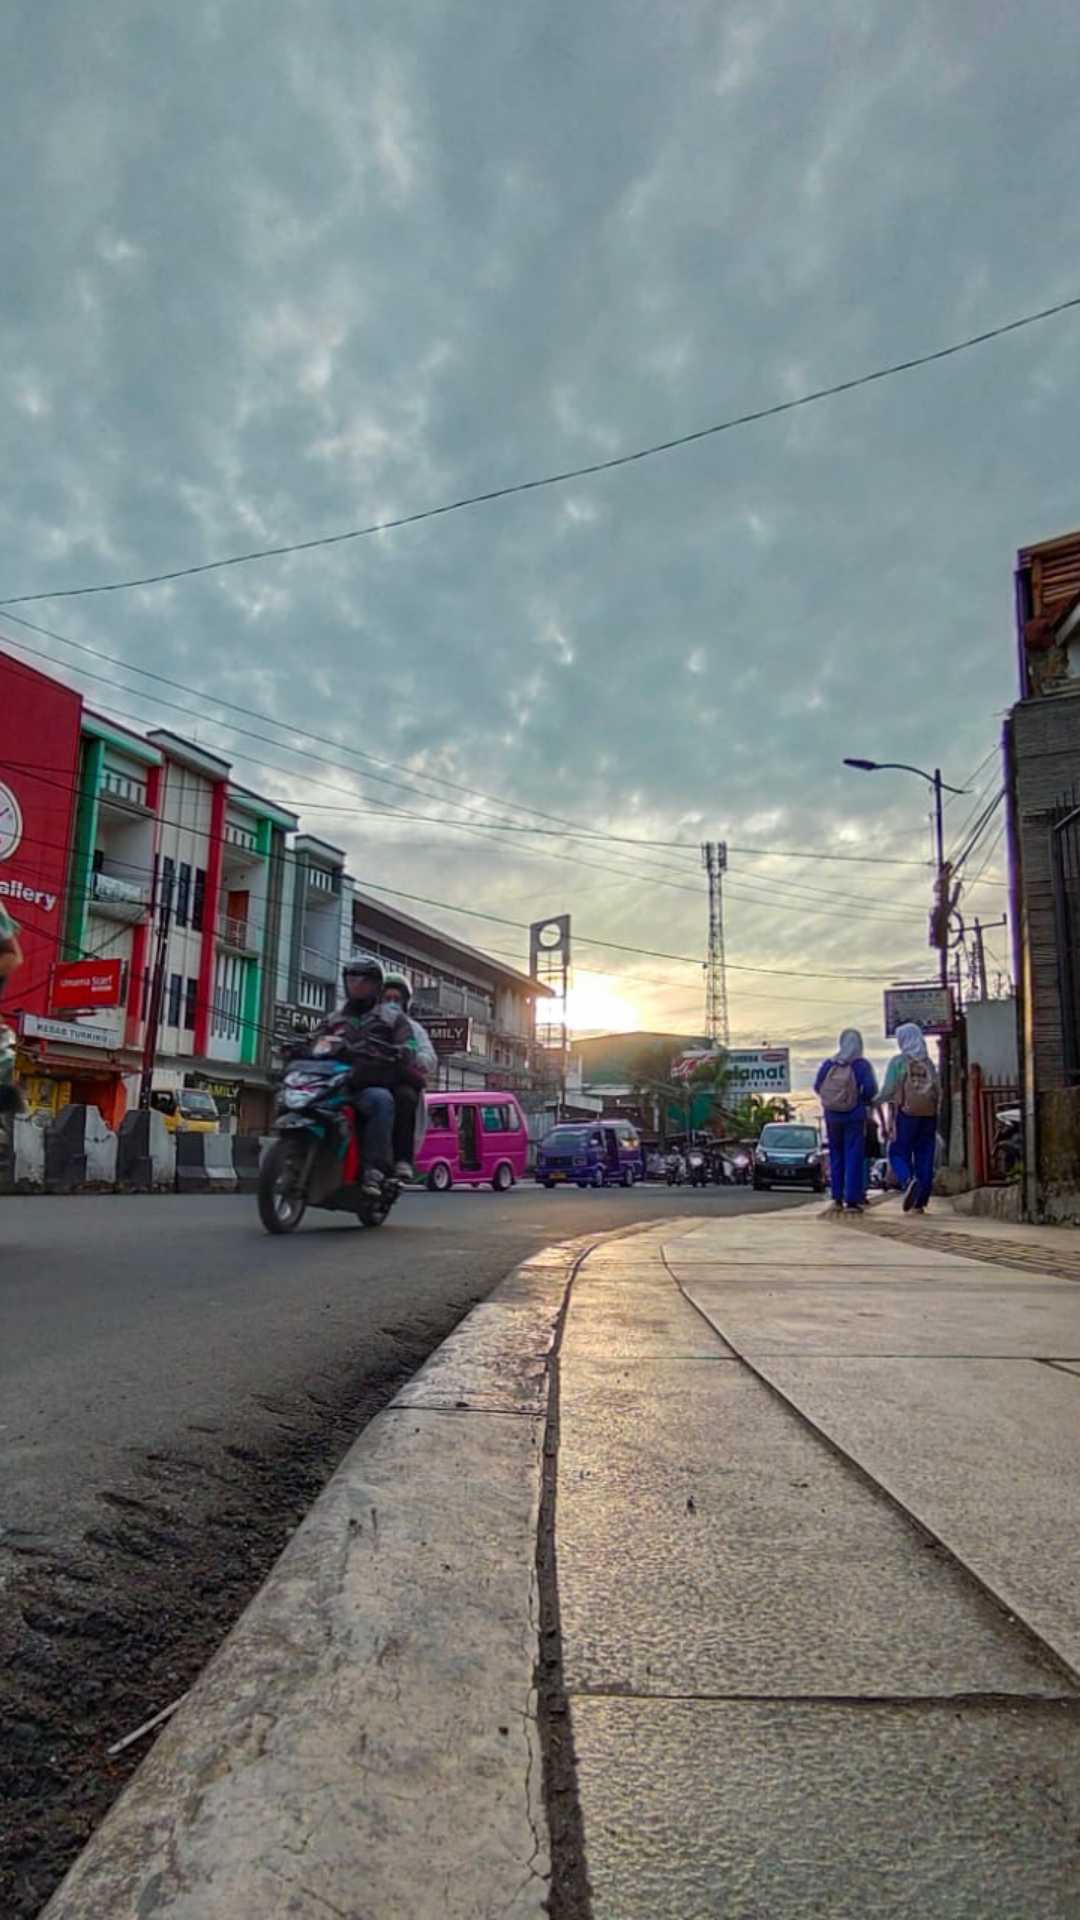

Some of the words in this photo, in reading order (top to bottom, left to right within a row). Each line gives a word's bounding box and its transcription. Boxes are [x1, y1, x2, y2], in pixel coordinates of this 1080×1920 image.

[0, 880, 57, 912] allery
[291, 1011, 322, 1032] FAM
[430, 1027, 464, 1039] MILY
[724, 1064, 786, 1081] elamat
